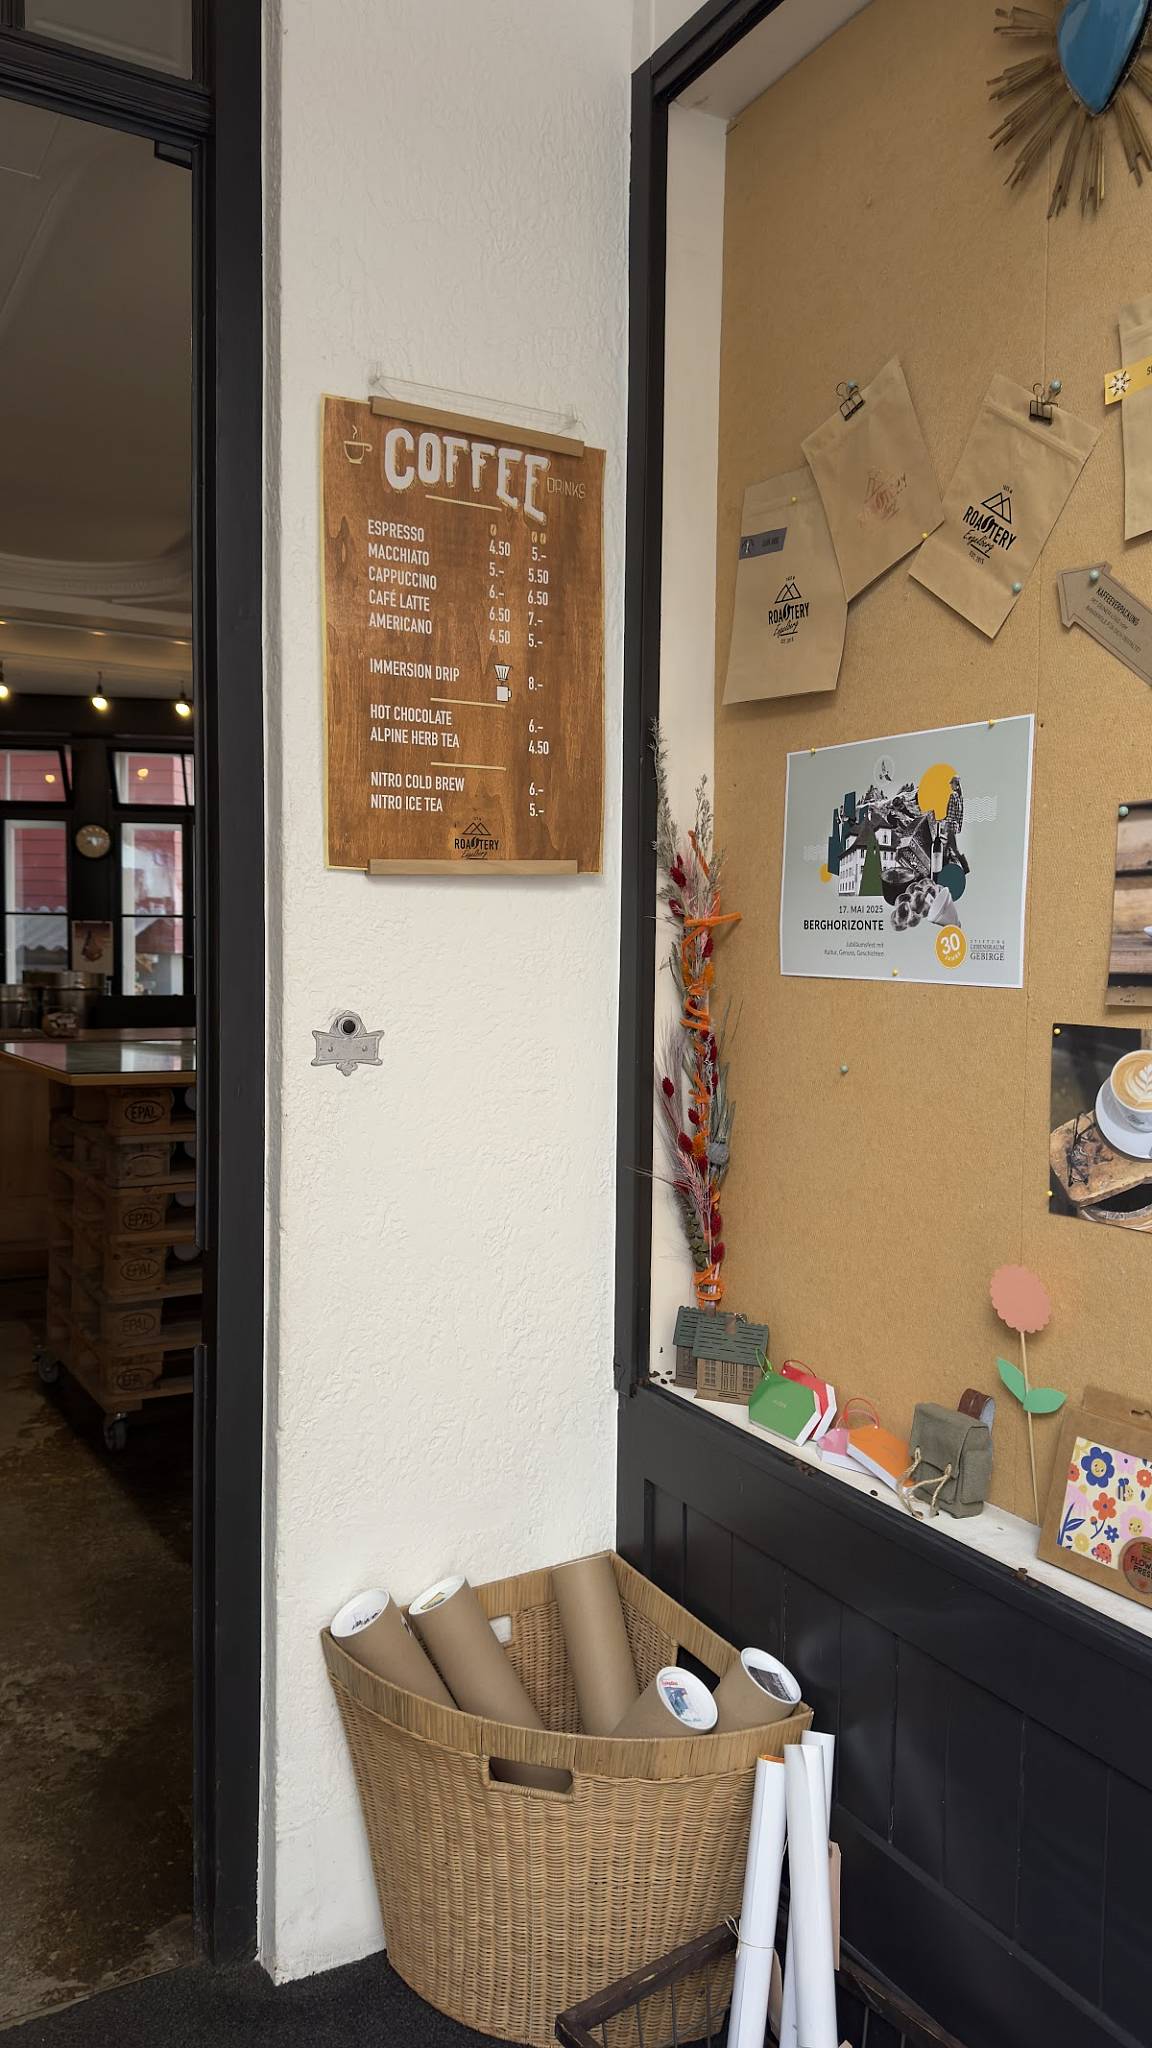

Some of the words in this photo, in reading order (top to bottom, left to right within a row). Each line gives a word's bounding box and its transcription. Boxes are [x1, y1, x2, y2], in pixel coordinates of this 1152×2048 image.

[384, 427, 551, 526] COFFEE
[546, 476, 586, 499] DRINKS
[368, 519, 425, 542] ESPRESSO
[489, 541, 511, 557] 4.50
[368, 542, 430, 567] MACCHIATO
[528, 568, 549, 585] 5.50
[368, 566, 437, 591] CAPPUCCINO
[527, 591, 549, 606] 6.50
[368, 588, 396, 607] CAFÉ
[399, 593, 430, 612] LATTE
[489, 607, 511, 623] 6.50
[368, 611, 432, 635] AMERICANO
[489, 629, 511, 644] 4.50
[369, 658, 432, 680] IMMERSION
[435, 666, 460, 682] DRIP
[370, 704, 391, 720] HOT
[394, 706, 452, 726] CHOCOLATE
[370, 727, 408, 744] ALPINE
[411, 730, 438, 746] HERB
[441, 733, 460, 748] TEA
[528, 741, 549, 755] 4.50
[371, 772, 402, 788] NITRO
[405, 774, 432, 790] COLD
[435, 776, 465, 792] BREW
[370, 794, 402, 810] NITRO
[405, 795, 423, 811] ICE
[424, 797, 443, 812] TEA
[839, 905, 849, 914] 17.
[850, 905, 865, 914] MAI
[866, 904, 884, 914] 2025
[803, 919, 884, 931] BERGHORIZONTE
[940, 932, 961, 955] 30
[969, 952, 1005, 961] GEBIRGE
[130, 1103, 158, 1121] EPAL
[128, 1212, 154, 1227] EPAL
[126, 1262, 153, 1278] EPAL
